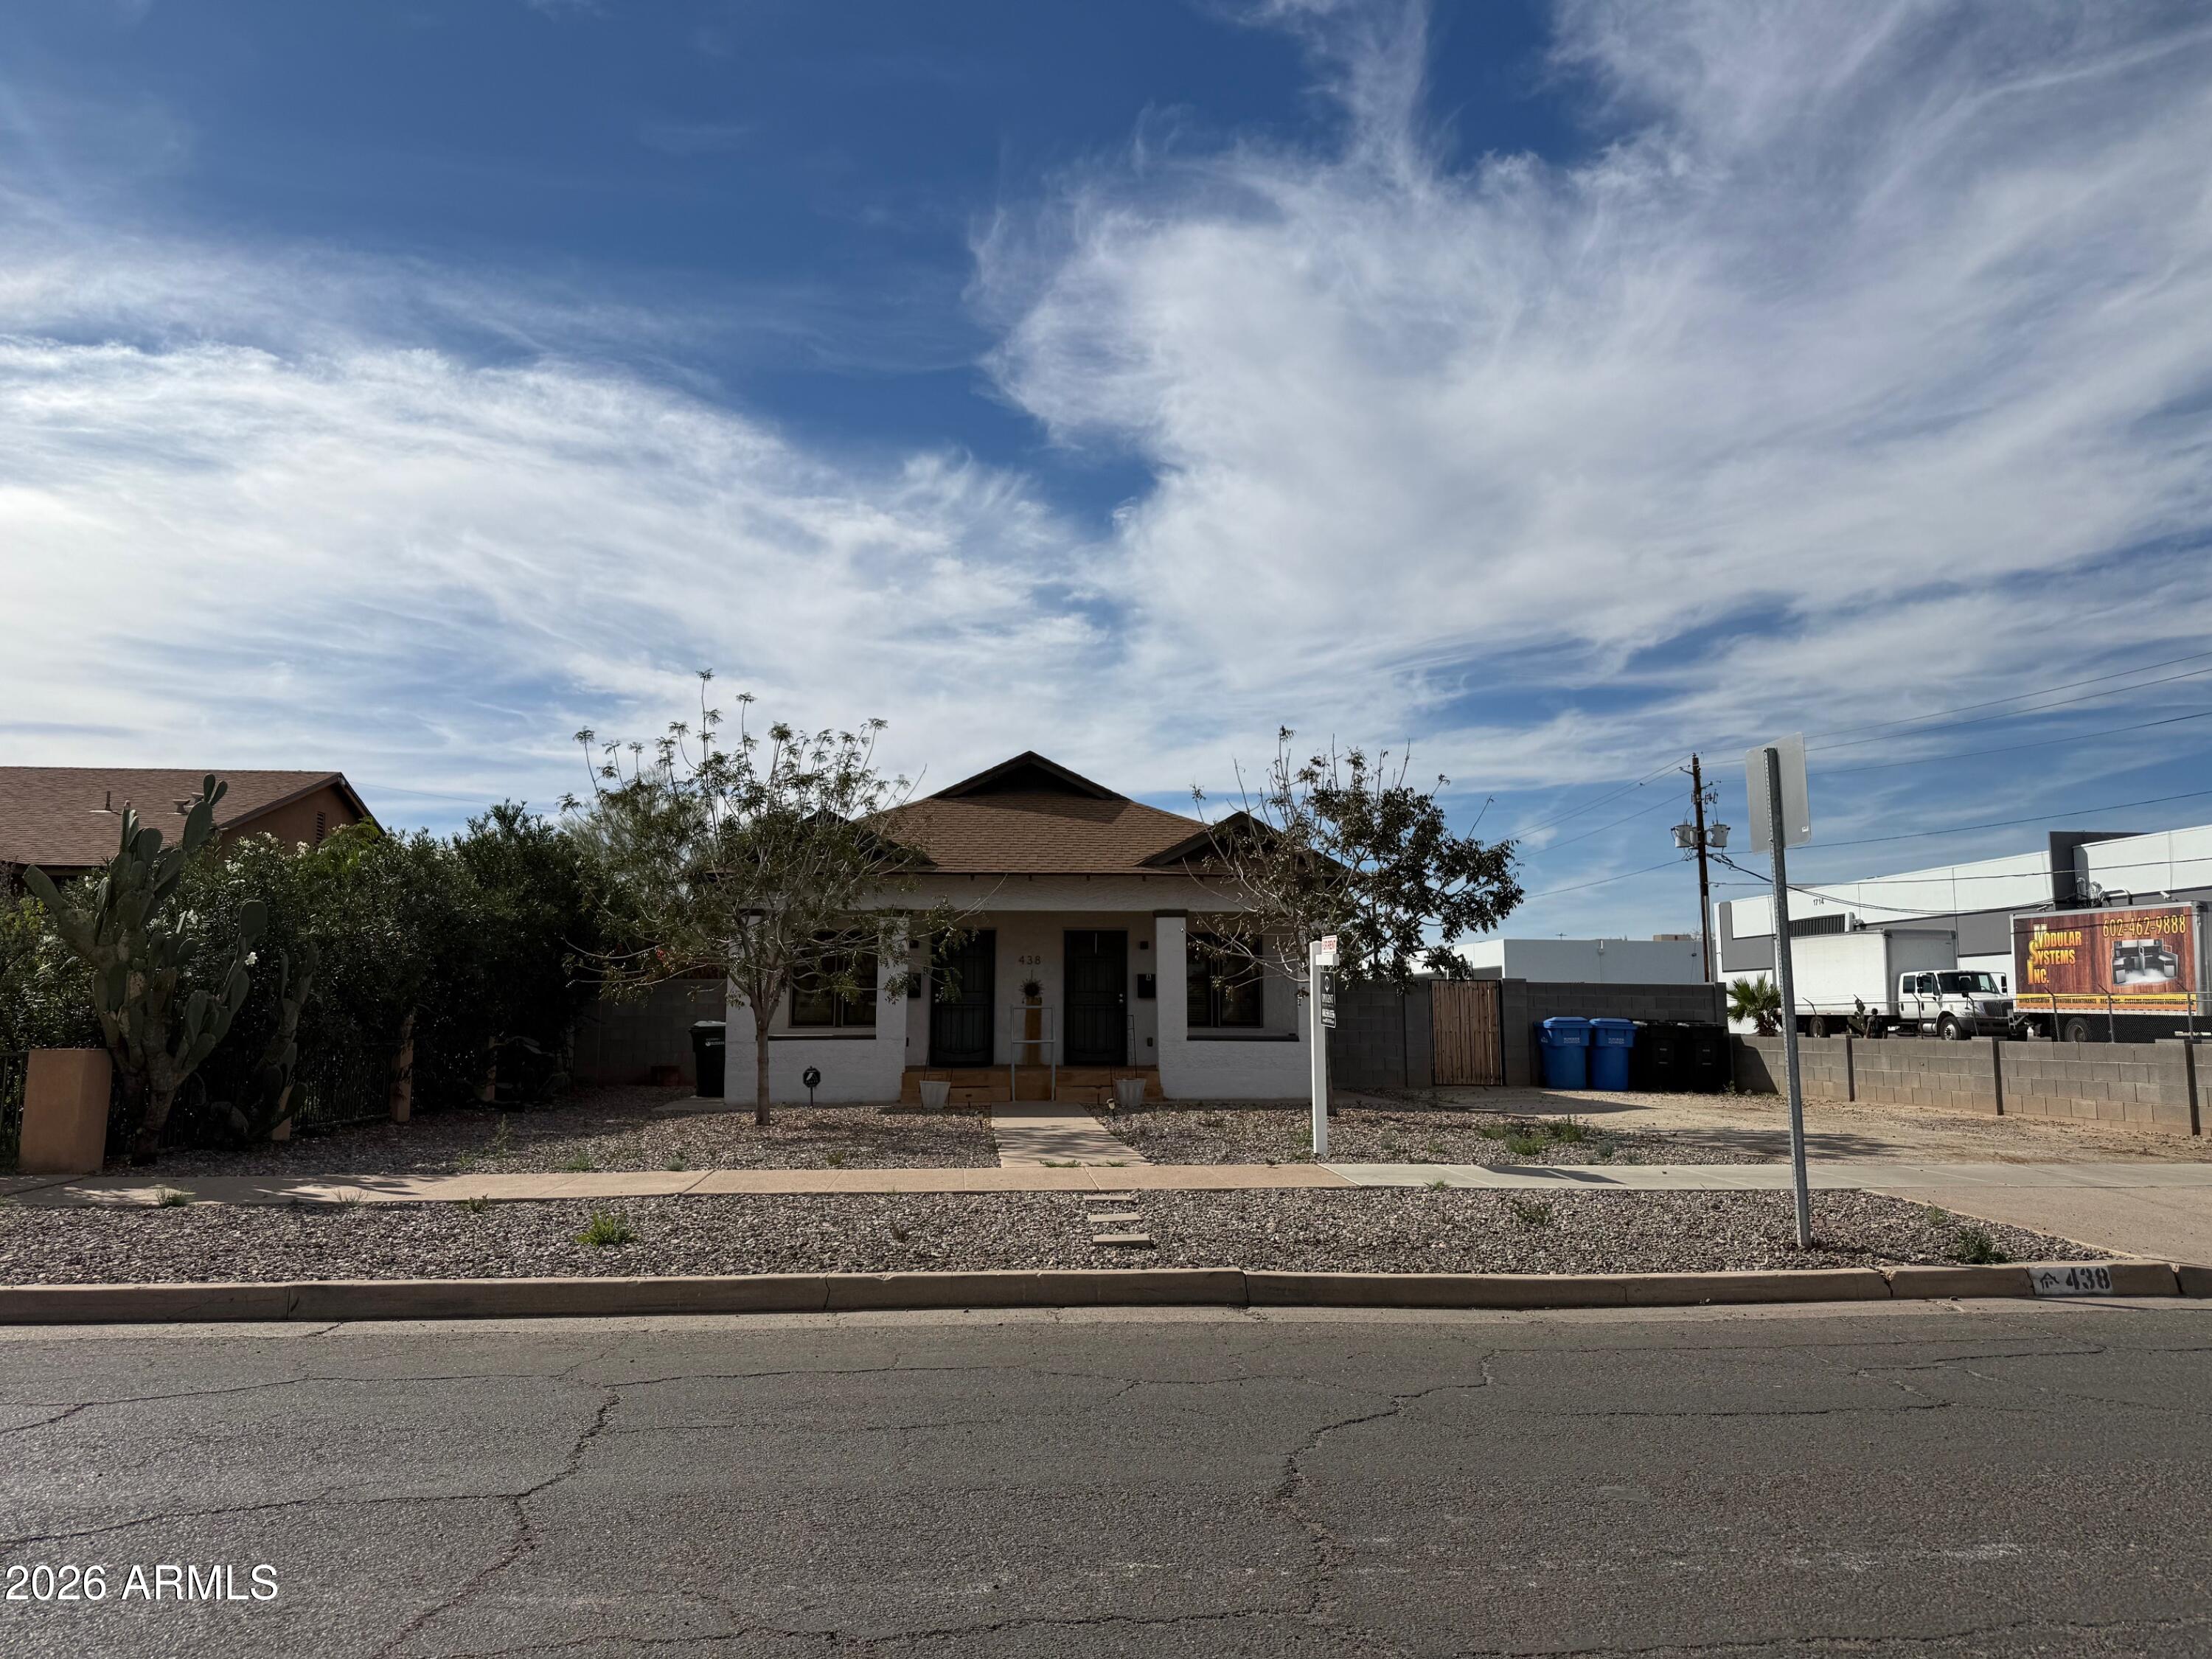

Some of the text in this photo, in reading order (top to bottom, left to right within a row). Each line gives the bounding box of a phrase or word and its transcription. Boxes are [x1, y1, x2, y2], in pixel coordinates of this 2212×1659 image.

[2034, 924, 2081, 948] MODULAR
[2103, 914, 2186, 937] 602-462-9888
[1018, 955, 1041, 965] 438
[2029, 939, 2076, 965] SYSTEMS
[2027, 959, 2049, 984] INC.
[2066, 1267, 2111, 1290] 438
